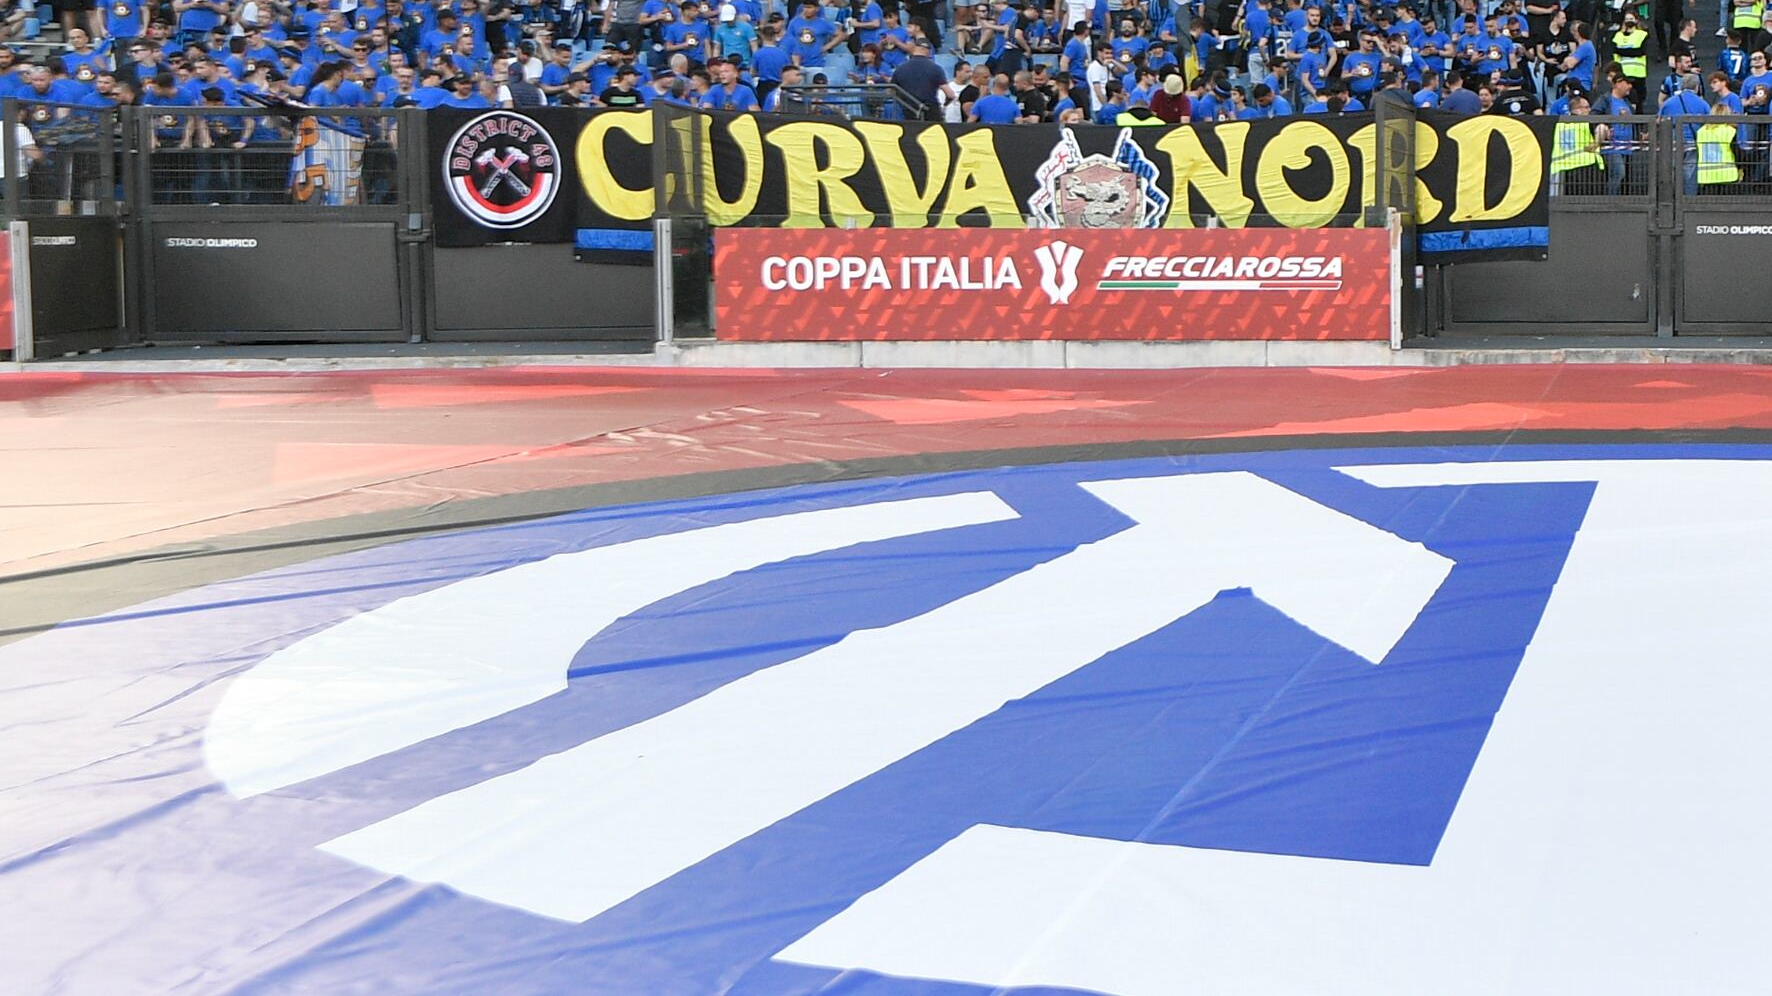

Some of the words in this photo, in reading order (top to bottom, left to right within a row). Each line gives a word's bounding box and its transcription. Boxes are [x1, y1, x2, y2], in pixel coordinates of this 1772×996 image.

[452, 117, 537, 170] DISTRICT
[532, 143, 554, 167] 48
[575, 110, 1029, 229] CURVA
[1156, 114, 1543, 229] NORD
[166, 238, 205, 247] STADIO
[206, 238, 257, 248] OLIMPICO
[1696, 225, 1729, 235] STADIO
[761, 255, 891, 291] COPPA
[902, 256, 1022, 291] ITALIA
[1102, 256, 1343, 278] FRECCIAROSSA
